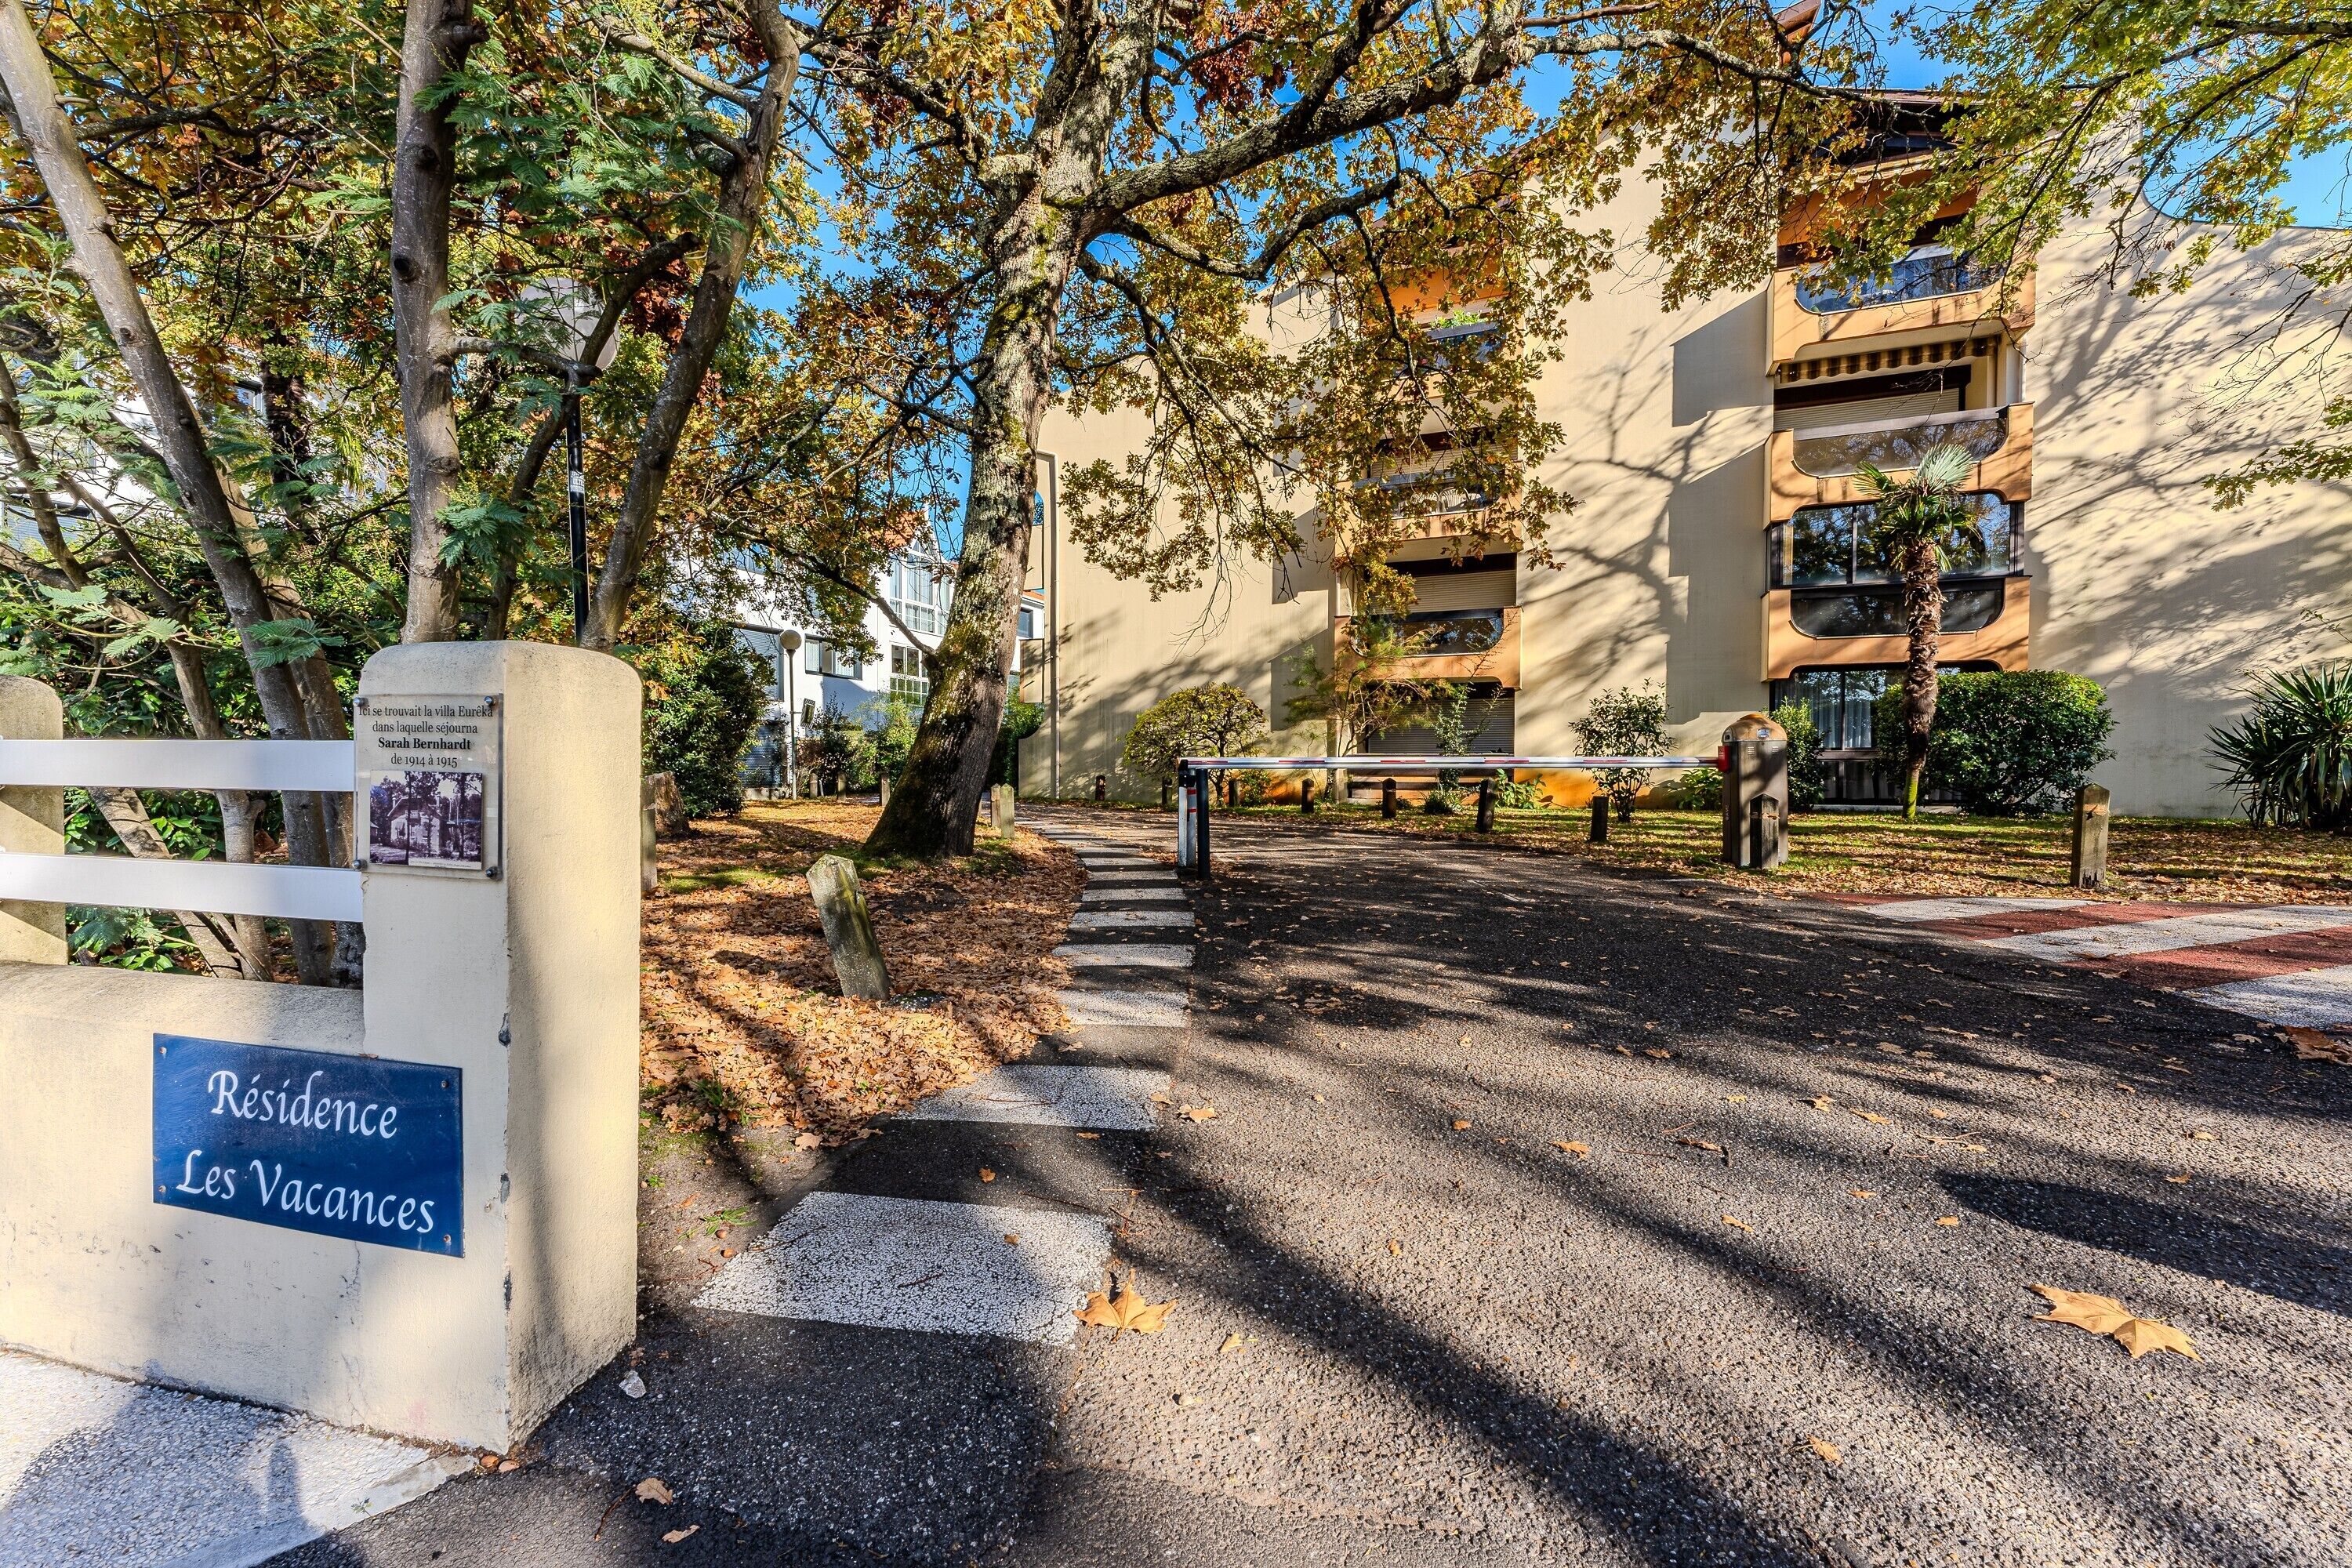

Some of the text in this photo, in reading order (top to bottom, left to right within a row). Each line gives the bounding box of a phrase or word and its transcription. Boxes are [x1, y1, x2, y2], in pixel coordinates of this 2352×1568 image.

[359, 705, 371, 716] Ici
[385, 706, 422, 717] trouvait
[423, 705, 433, 717] la
[434, 705, 455, 717] villa
[459, 706, 493, 717] Eurêka
[372, 720, 478, 735] dans laquelle séjourna
[378, 737, 472, 750] Sarah Bernhardt
[390, 753, 458, 768] de 1914 à 1915
[208, 1069, 397, 1139] Résidence
[176, 1150, 435, 1233] Les Vacances
